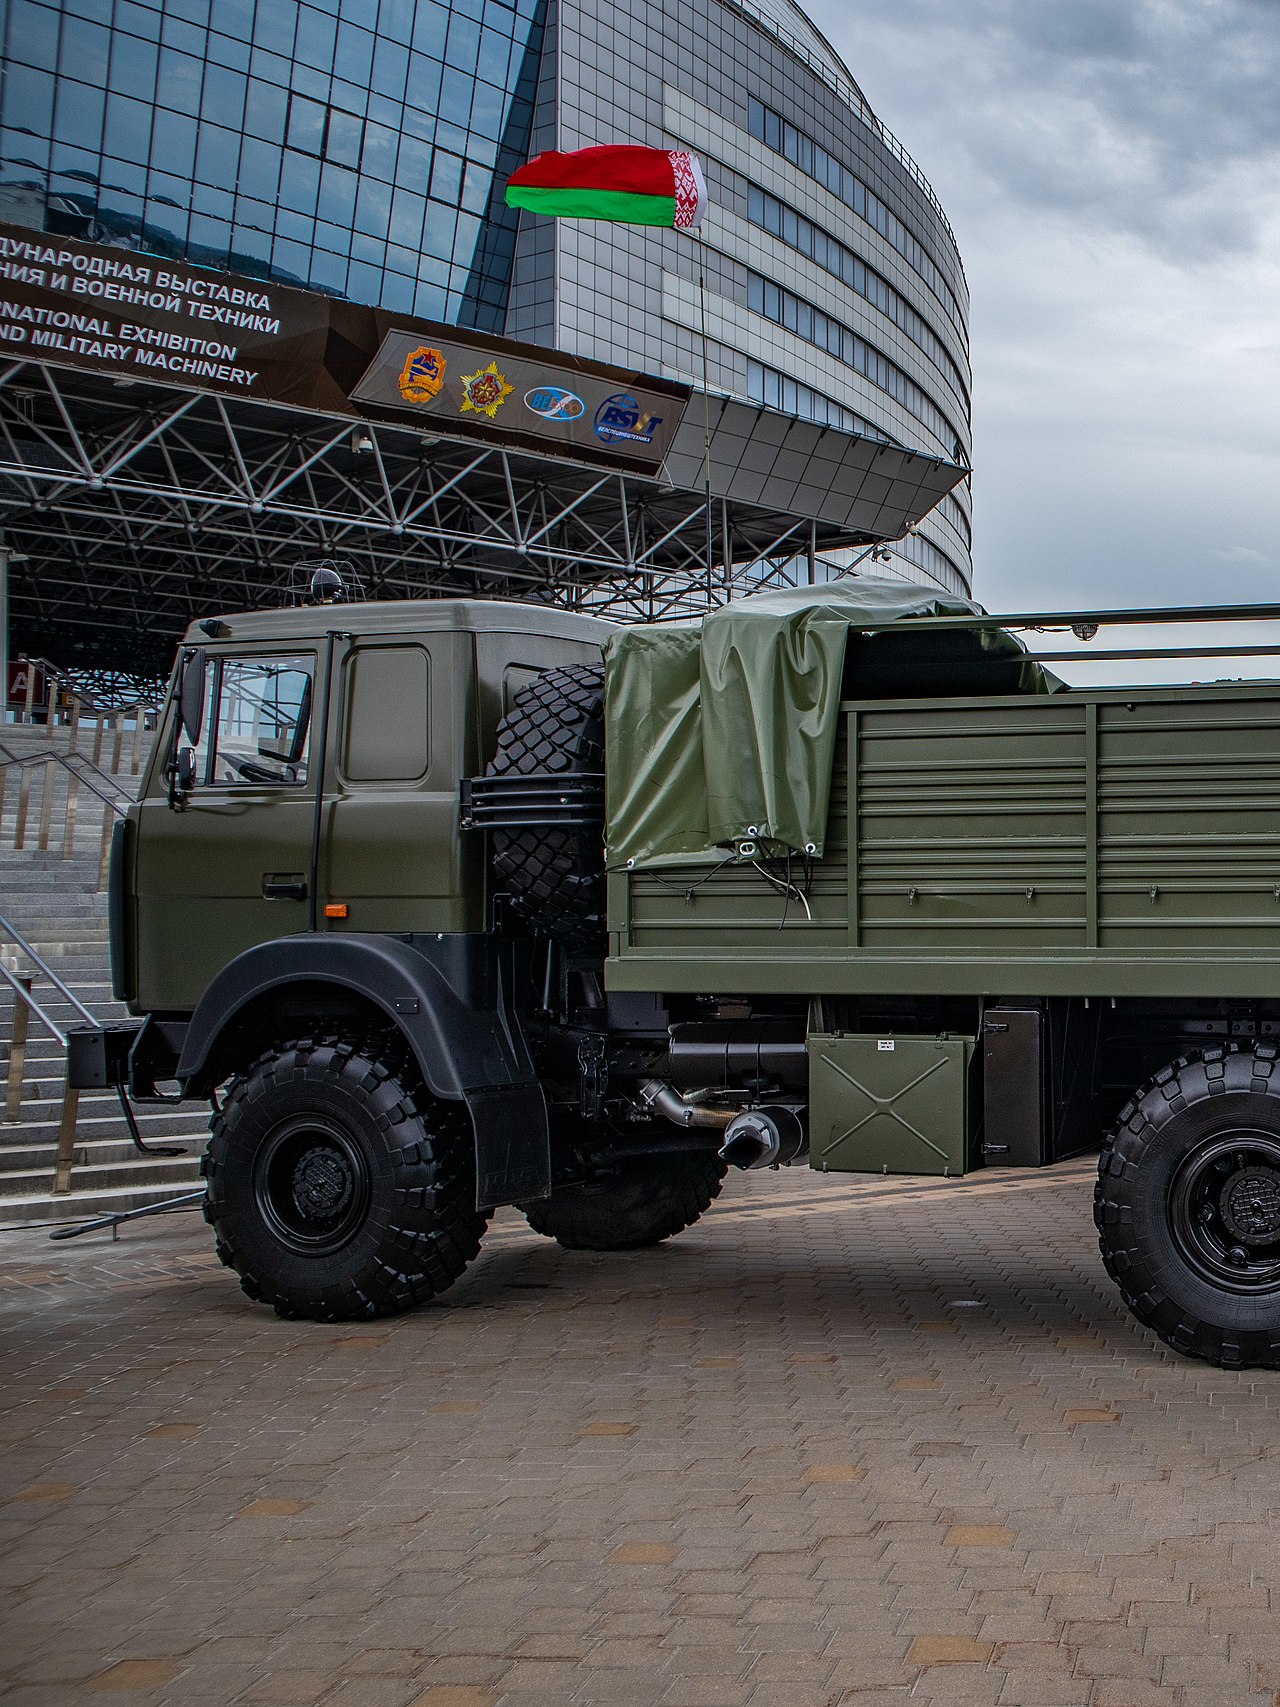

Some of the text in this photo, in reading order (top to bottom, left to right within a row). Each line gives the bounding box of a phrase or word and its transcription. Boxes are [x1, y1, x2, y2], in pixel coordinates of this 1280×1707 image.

[50, 272, 67, 291] И
[72, 276, 182, 313] ВОЕННОЙ
[187, 300, 281, 334] ТЕХНИКИ
[155, 271, 271, 311] ВЫСТАВКА
[0, 301, 238, 361] NATIONAL EXHIBITION
[31, 329, 132, 360] MILITARY
[135, 348, 259, 385] MACHINERY
